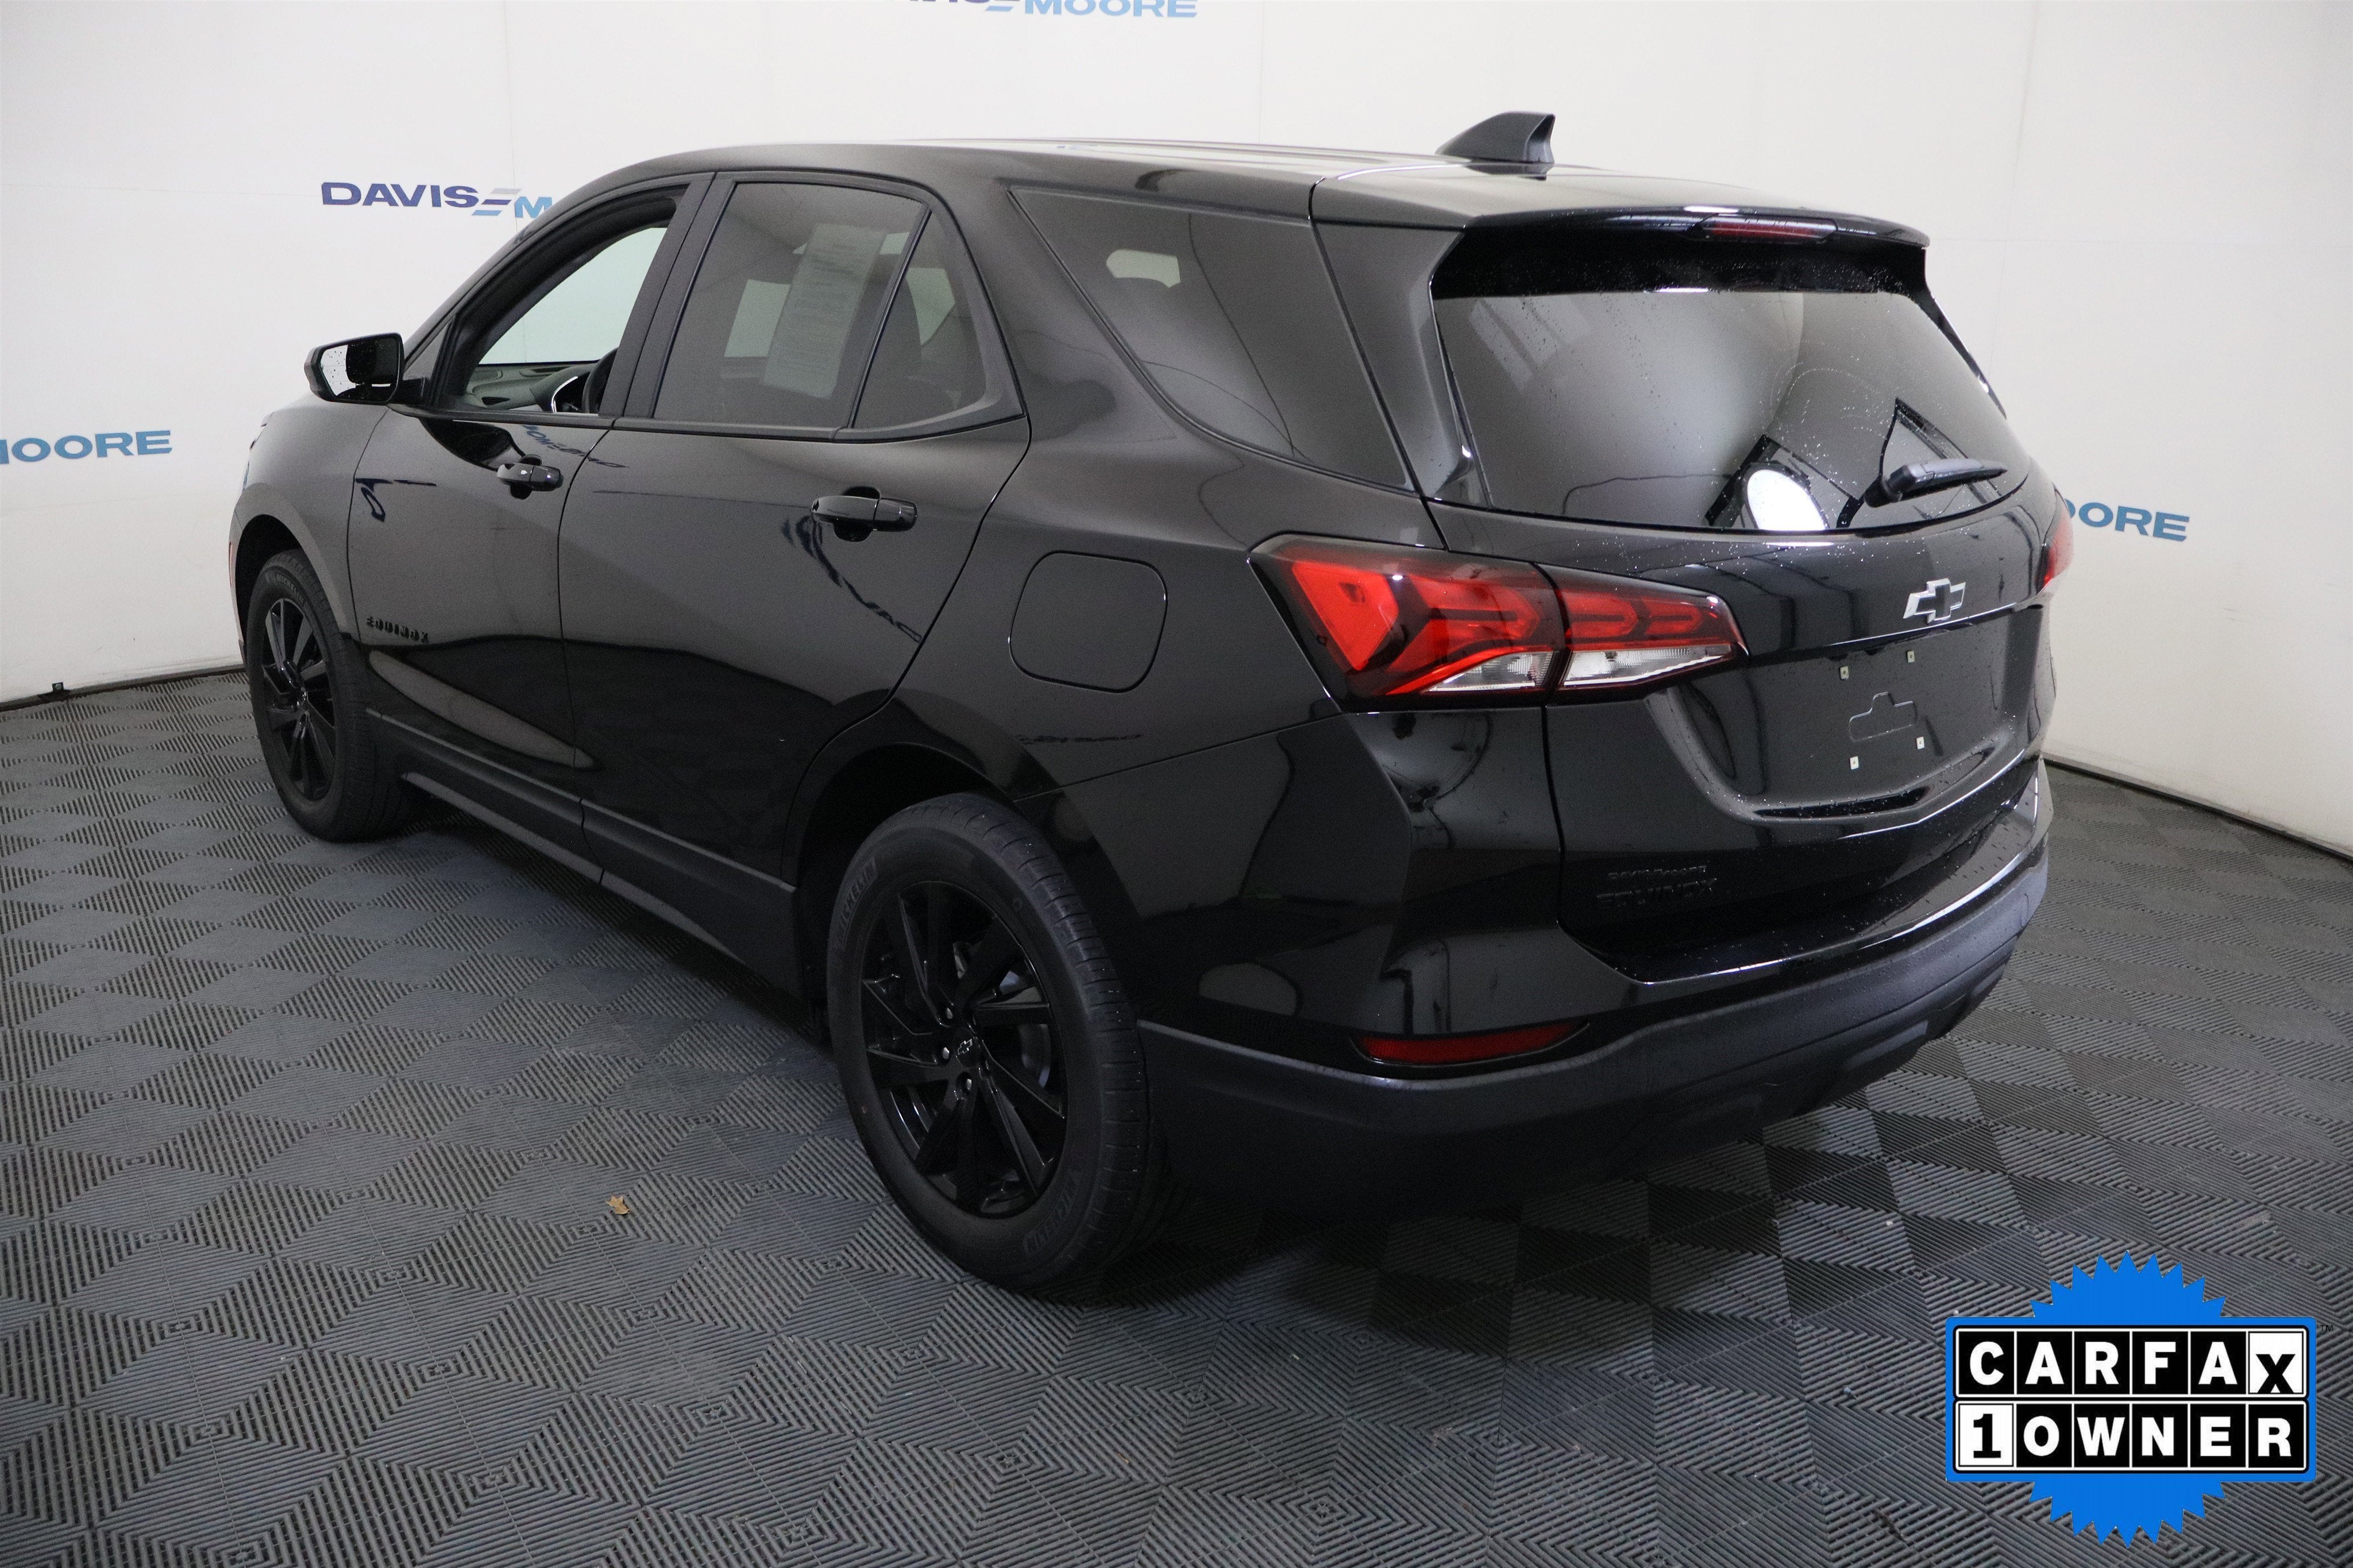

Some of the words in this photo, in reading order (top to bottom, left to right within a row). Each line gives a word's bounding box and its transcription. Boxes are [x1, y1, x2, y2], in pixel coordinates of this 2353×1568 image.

[1024, 0, 1197, 17] MOORE
[321, 182, 480, 208] DAVIS
[0, 430, 172, 464] OORE
[2065, 498, 2190, 542] ORE
